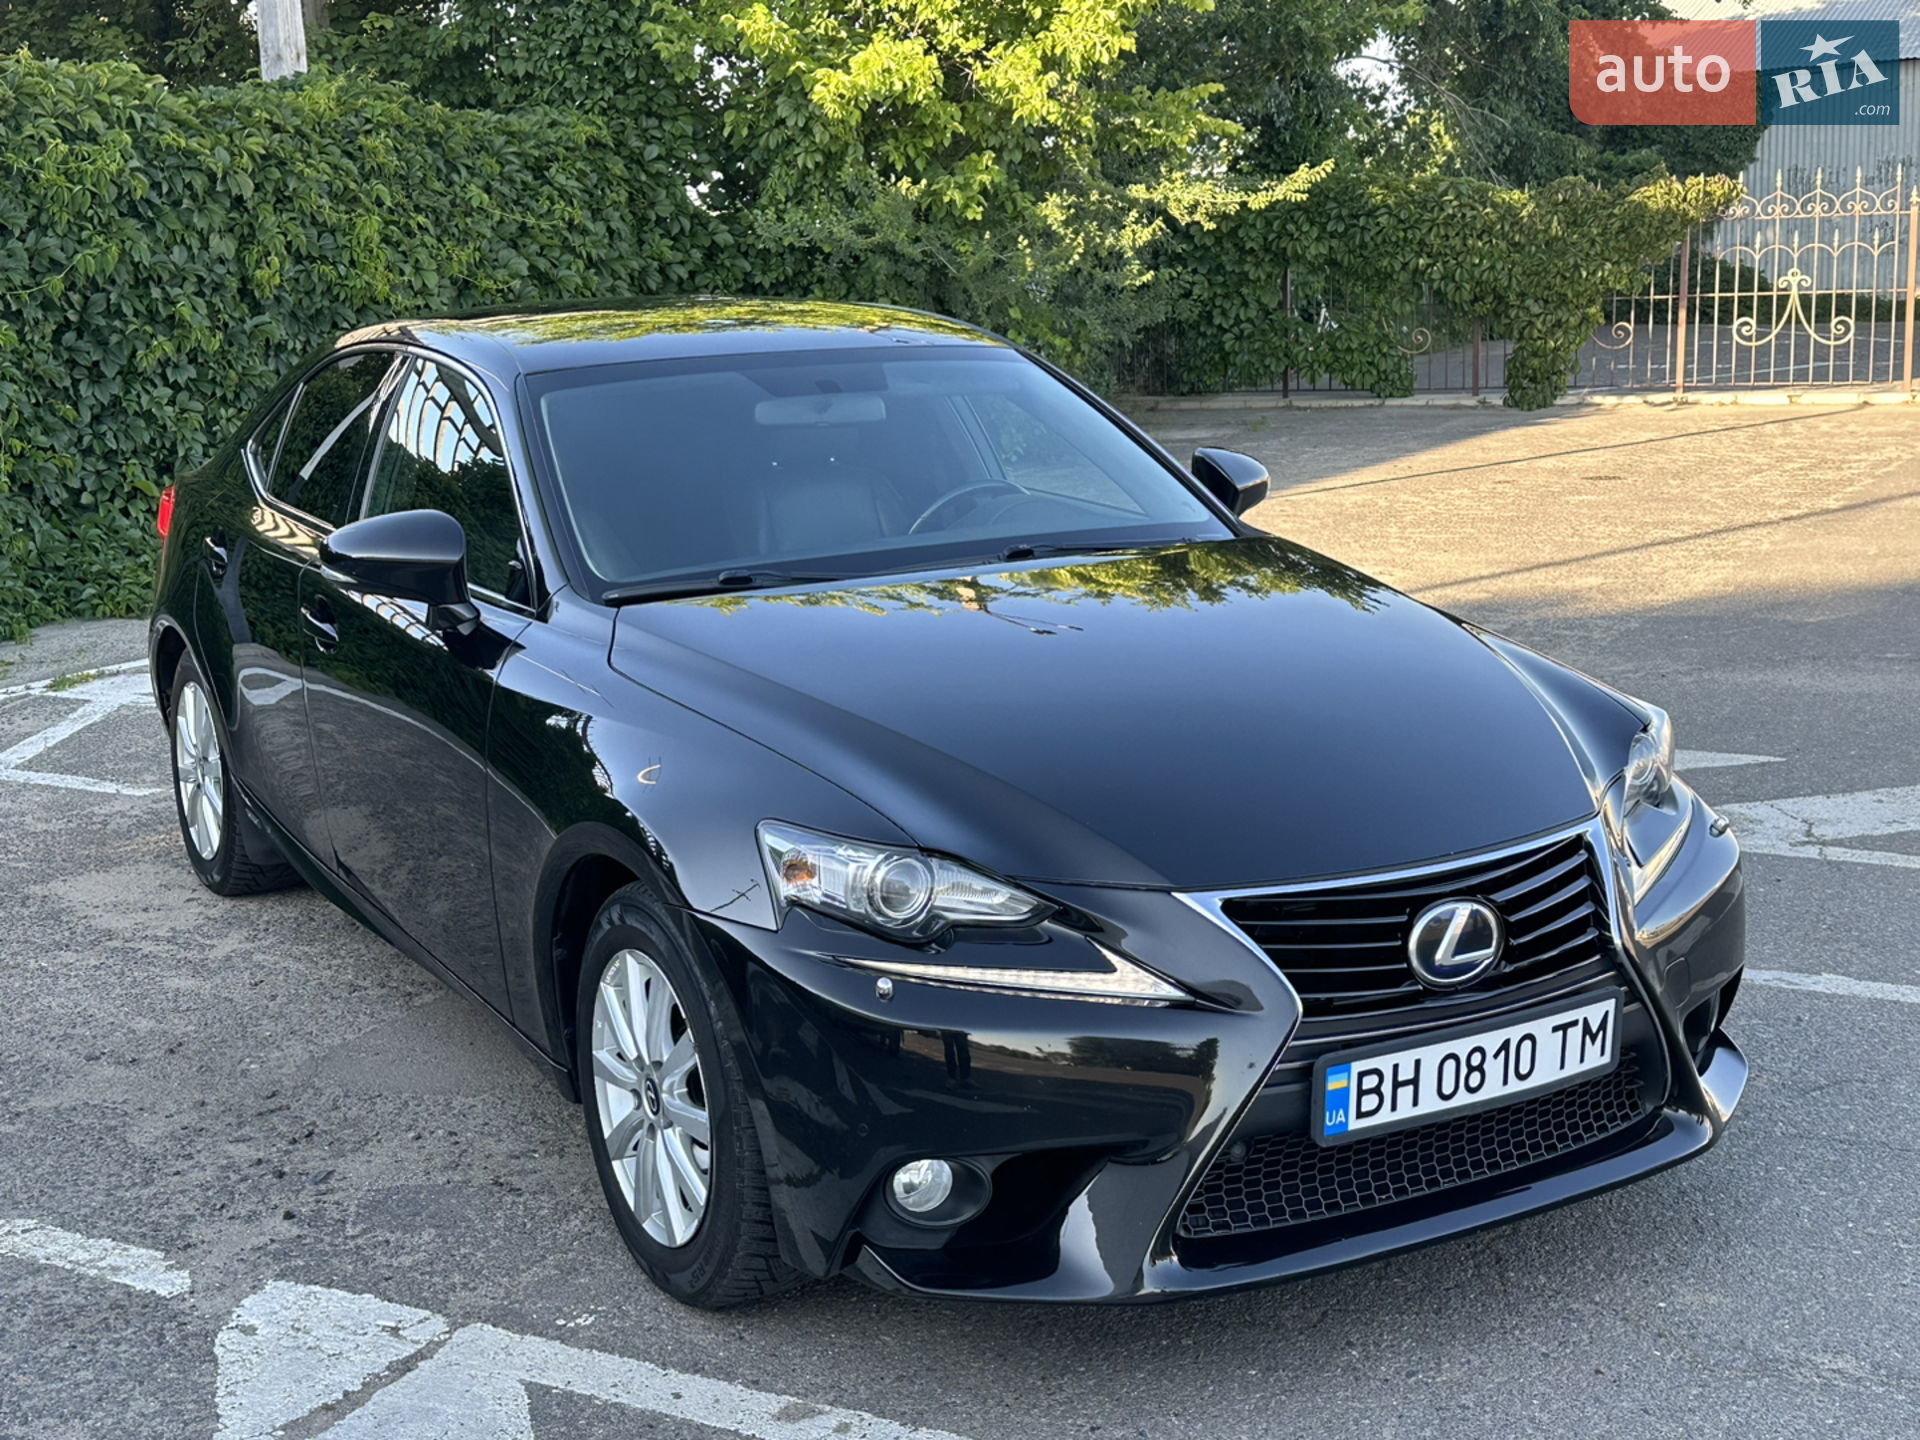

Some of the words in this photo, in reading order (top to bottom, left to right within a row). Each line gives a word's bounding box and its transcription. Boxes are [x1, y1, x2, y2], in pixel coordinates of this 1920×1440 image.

[1355, 1058, 1422, 1120] BH
[1436, 1033, 1537, 1102] 0810
[1551, 1009, 1610, 1071] TM
[1325, 1108, 1346, 1127] UA
